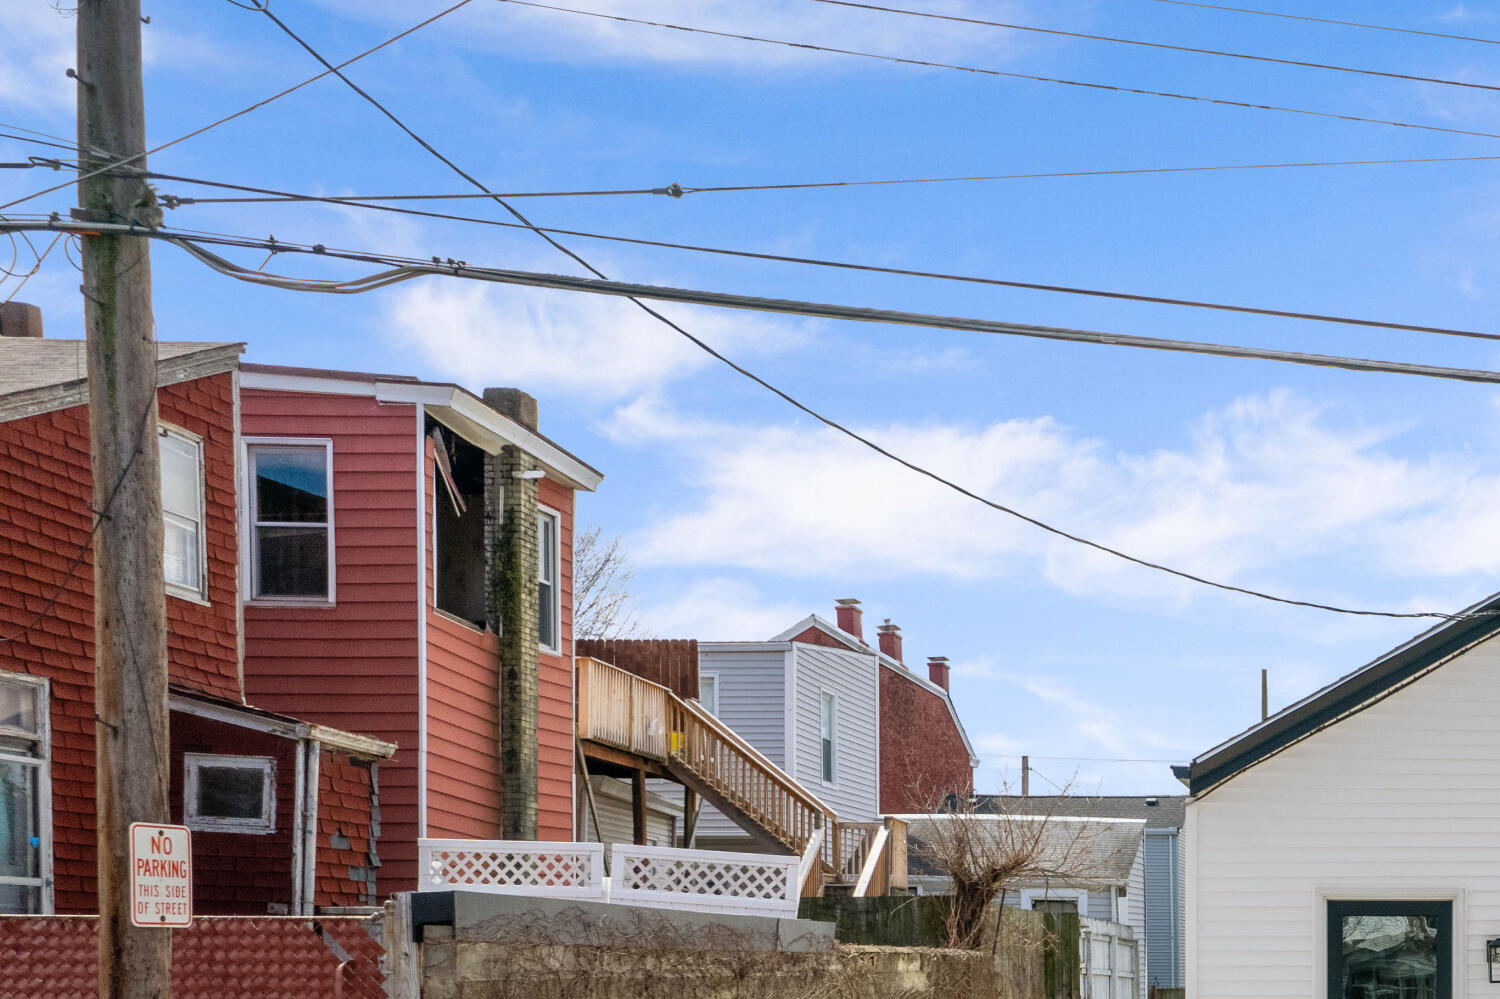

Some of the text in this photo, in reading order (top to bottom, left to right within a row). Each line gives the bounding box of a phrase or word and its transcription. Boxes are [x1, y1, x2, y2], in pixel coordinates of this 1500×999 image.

[151, 836, 173, 855] NO
[137, 858, 187, 878] PARKING
[138, 885, 186, 898] THIS SIDE
[137, 902, 187, 915] OF STREET
